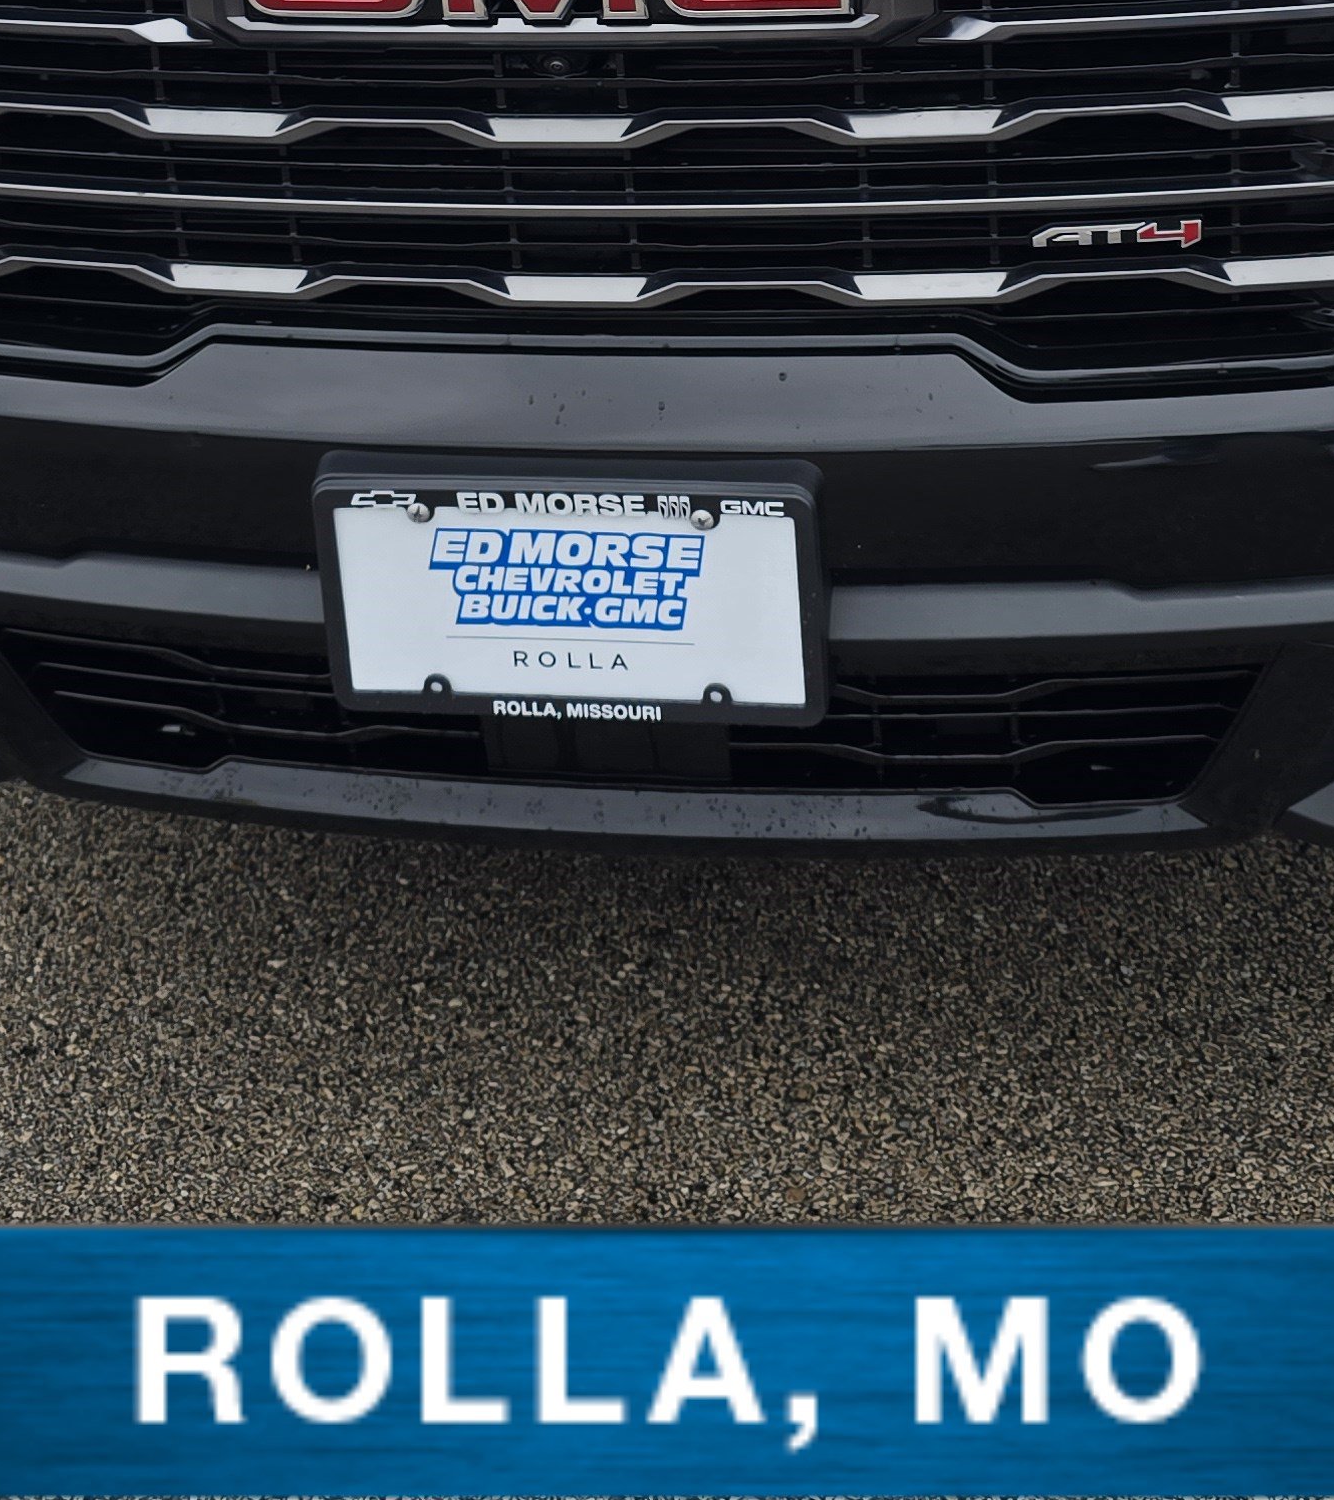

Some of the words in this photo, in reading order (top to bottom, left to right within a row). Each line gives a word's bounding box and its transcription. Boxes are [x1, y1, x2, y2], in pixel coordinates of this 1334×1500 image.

[1032, 219, 1202, 248] AT4
[456, 491, 505, 514] ED
[516, 492, 647, 517] MORSE
[720, 500, 785, 517] GMC
[431, 532, 503, 563] ED
[507, 533, 701, 570] MORSE
[454, 566, 685, 597] CHEVROLET
[513, 650, 628, 671] ROLLA
[492, 700, 562, 720] ROLLA,
[566, 702, 662, 722] MISSOURI
